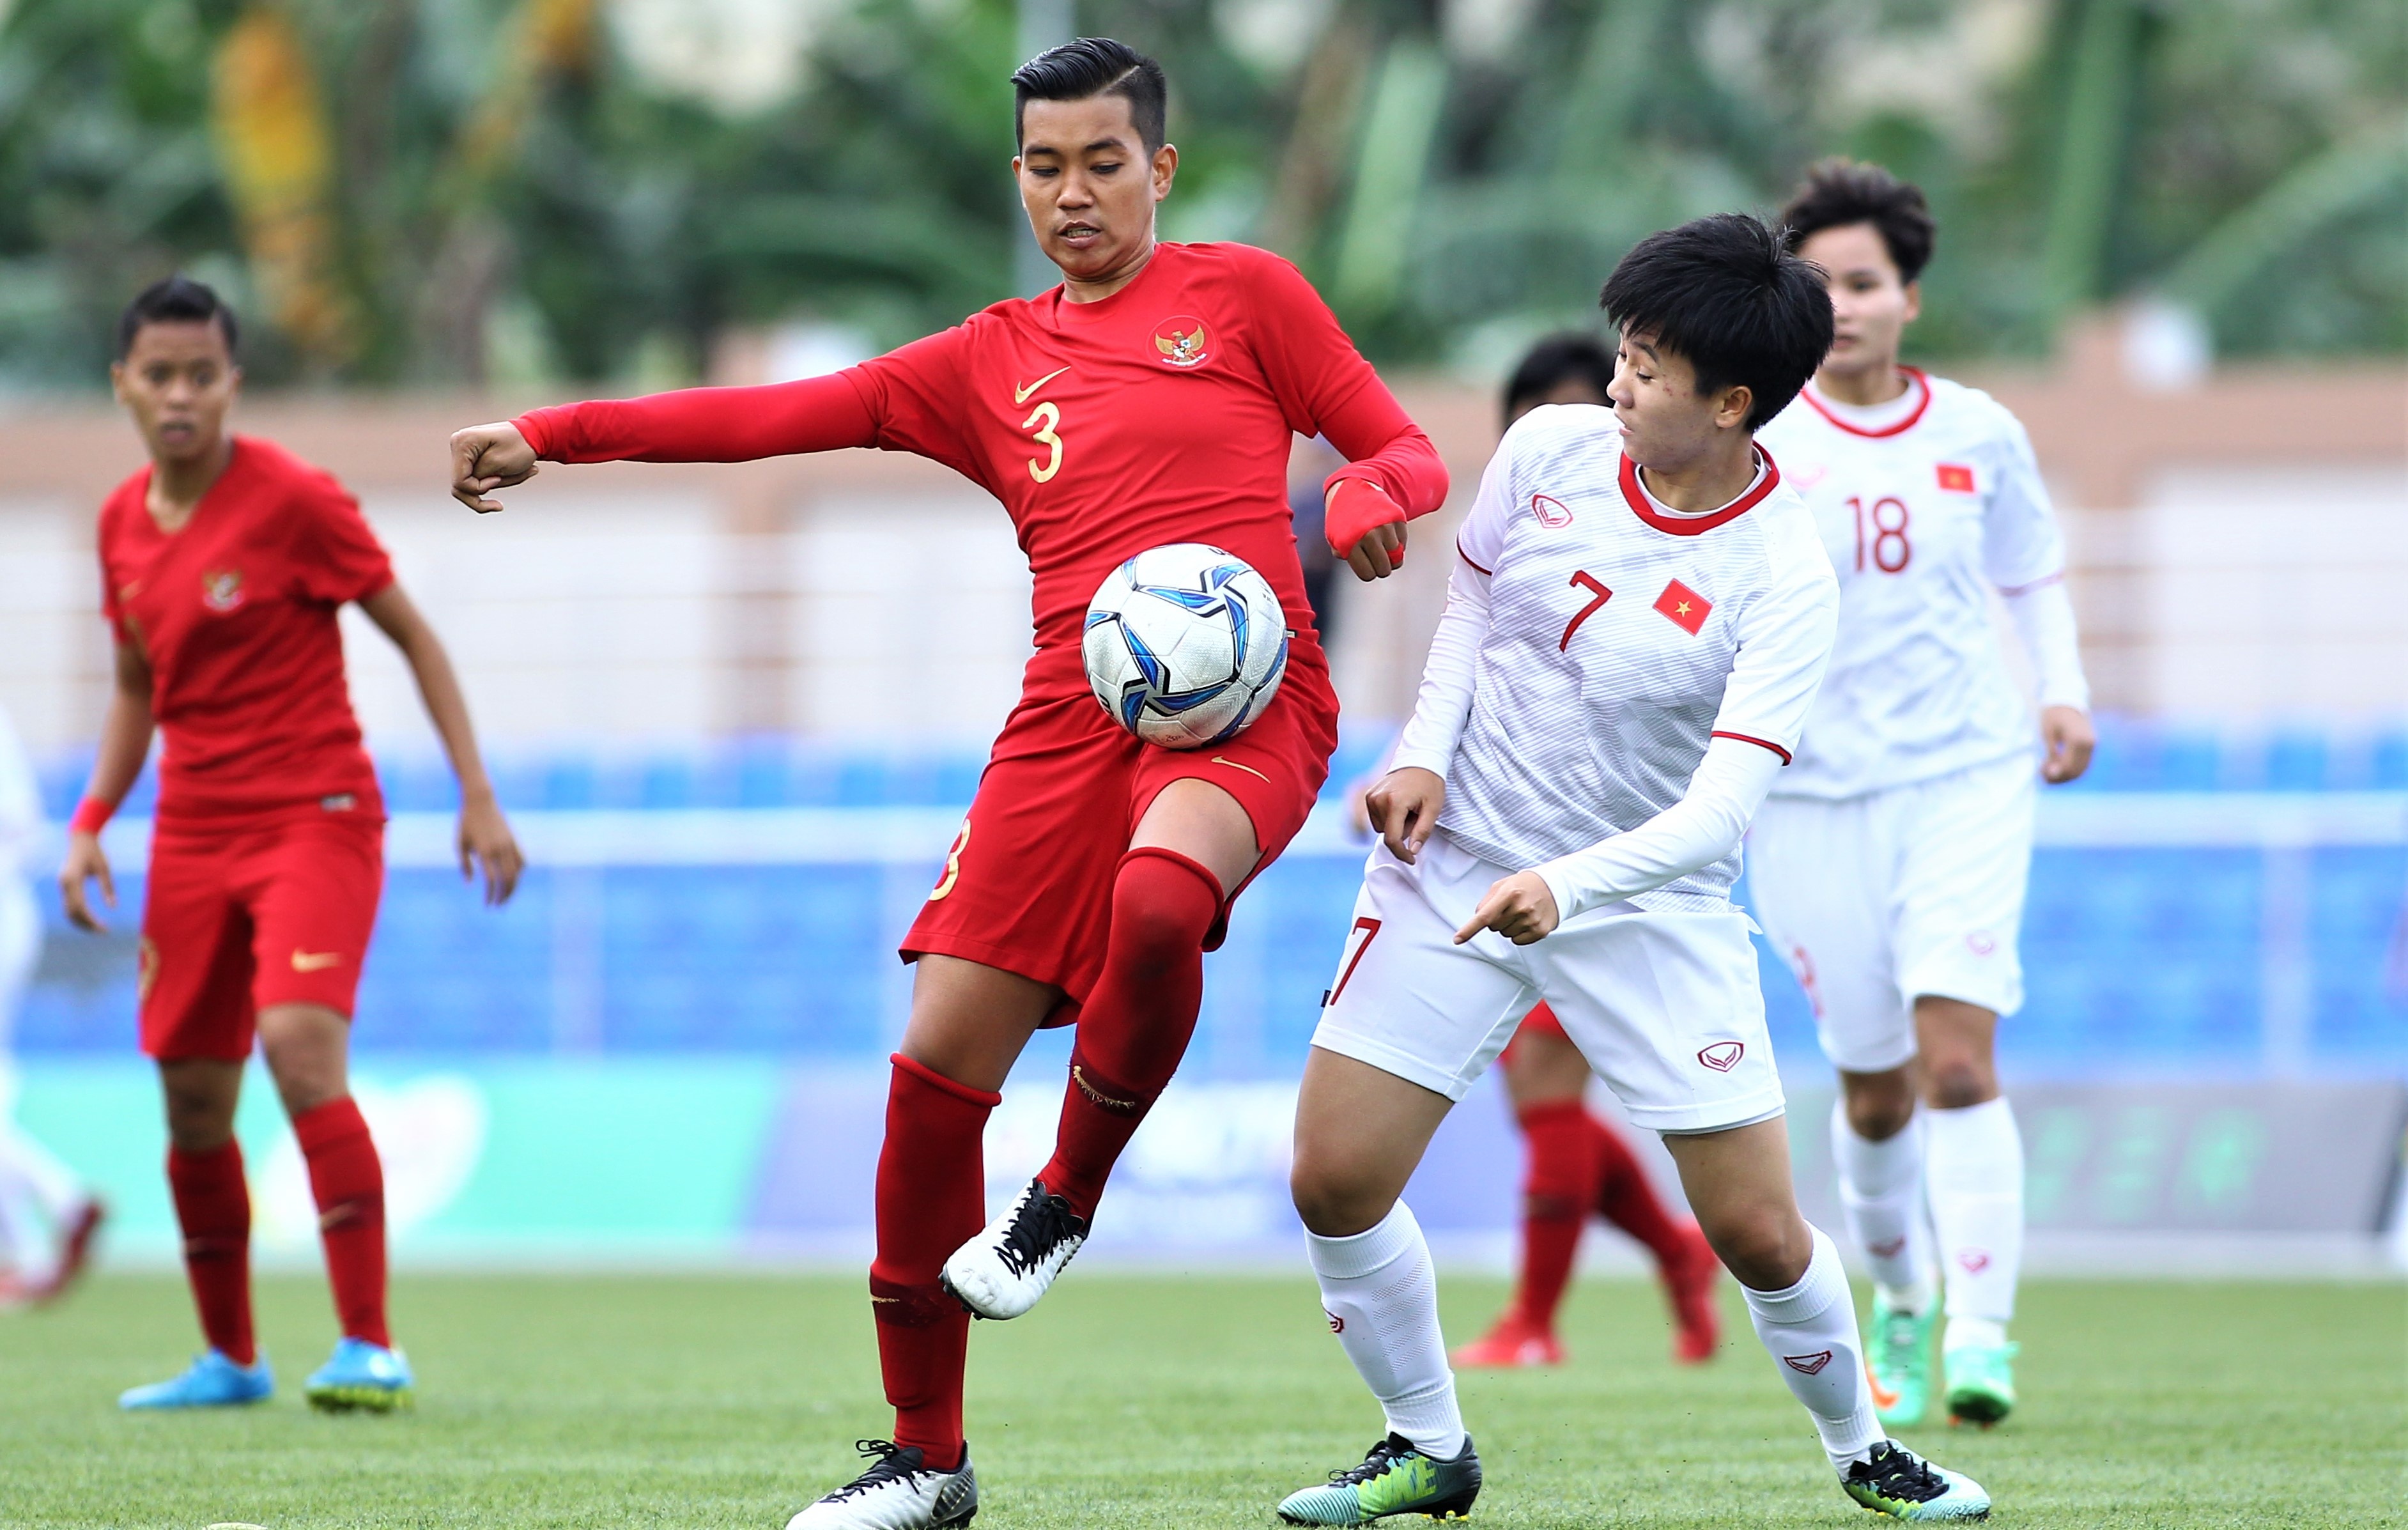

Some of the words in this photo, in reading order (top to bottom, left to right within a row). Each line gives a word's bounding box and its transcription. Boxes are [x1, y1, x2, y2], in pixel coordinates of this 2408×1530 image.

[1021, 401, 1063, 484] 3
[1845, 496, 1910, 573] 18
[1559, 570, 1614, 653] 7
[1329, 916, 1382, 1006] 7
